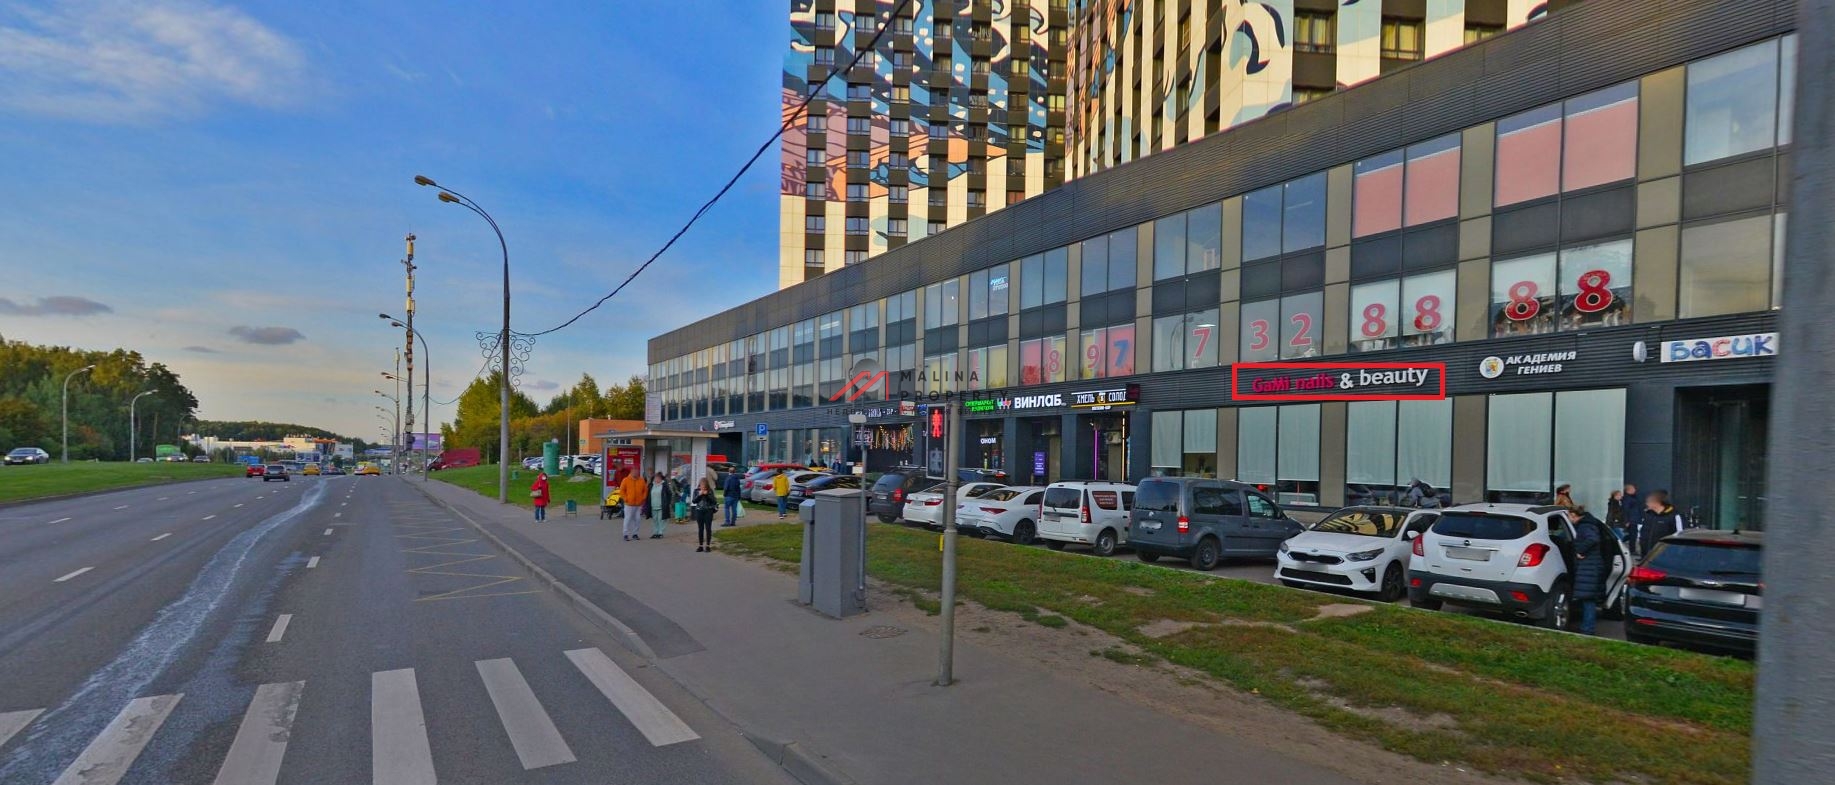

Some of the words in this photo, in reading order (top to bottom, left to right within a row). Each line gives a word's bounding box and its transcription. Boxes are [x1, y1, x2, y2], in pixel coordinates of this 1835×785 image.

[1048, 349, 1061, 374] 8
[1086, 344, 1100, 370] 9
[1113, 339, 1129, 368] 7
[1193, 327, 1211, 360] 7
[1250, 319, 1270, 351] 3
[1290, 313, 1313, 347] 2
[1361, 303, 1386, 338] 8
[1414, 295, 1441, 332] 8
[1505, 280, 1540, 321] 8
[1574, 269, 1613, 313] 8
[1505, 351, 1577, 365] АКАДЕМИЯ
[1517, 363, 1563, 375] ГЕНИЕВ
[1295, 373, 1335, 390] nails
[1339, 373, 1354, 389] &
[1360, 367, 1429, 387] beauty
[1076, 393, 1095, 404] ХМЕЛЬ
